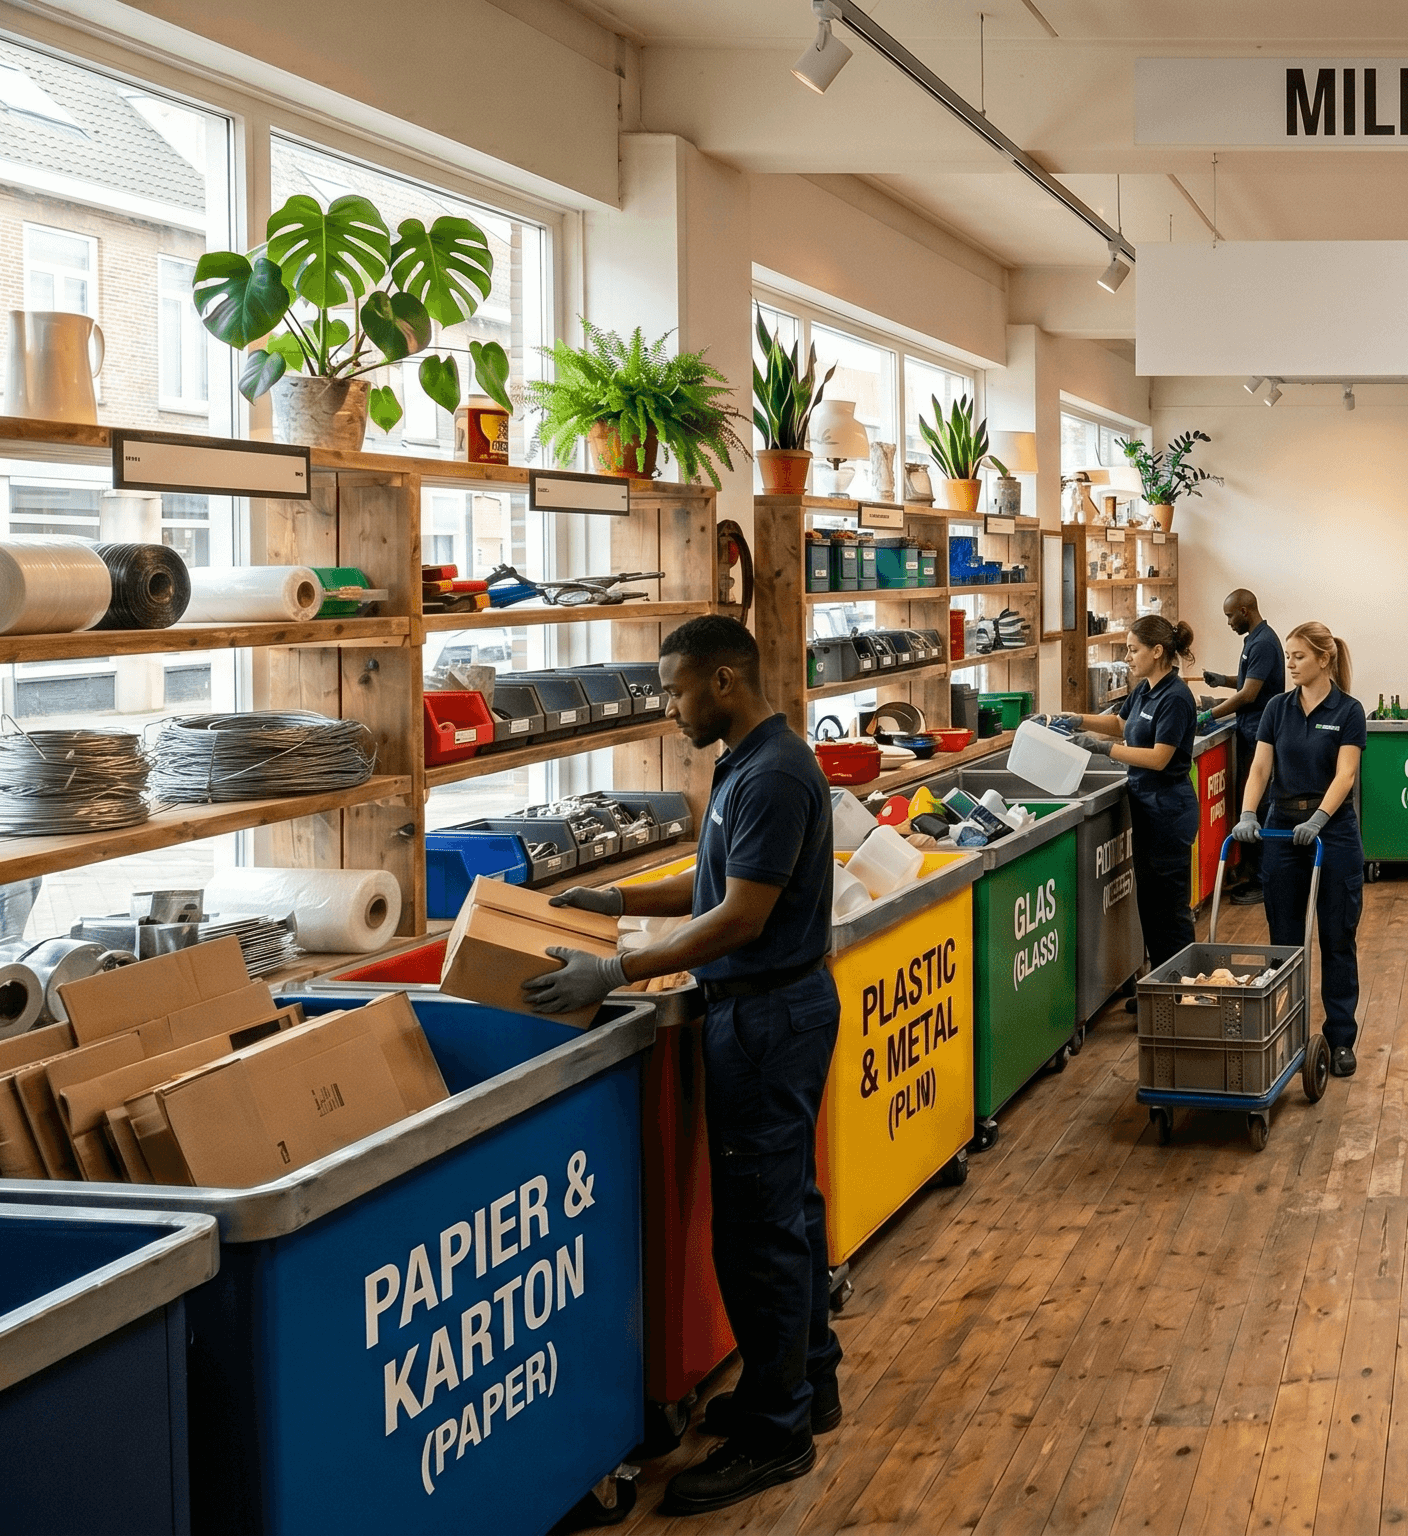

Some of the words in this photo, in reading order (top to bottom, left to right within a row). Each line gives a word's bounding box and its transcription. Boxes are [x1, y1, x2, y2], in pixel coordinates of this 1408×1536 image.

[1013, 929, 1059, 992] (GLASS)
[1014, 878, 1056, 941] GLAS
[863, 937, 956, 1037] PLASTIC
[860, 1048, 880, 1099] &
[888, 996, 959, 1083] METAL
[364, 1174, 550, 1349] PAPIER
[563, 1149, 597, 1218] &
[384, 1233, 585, 1437] KARTON
[421, 1340, 558, 1496] (PAPER)
